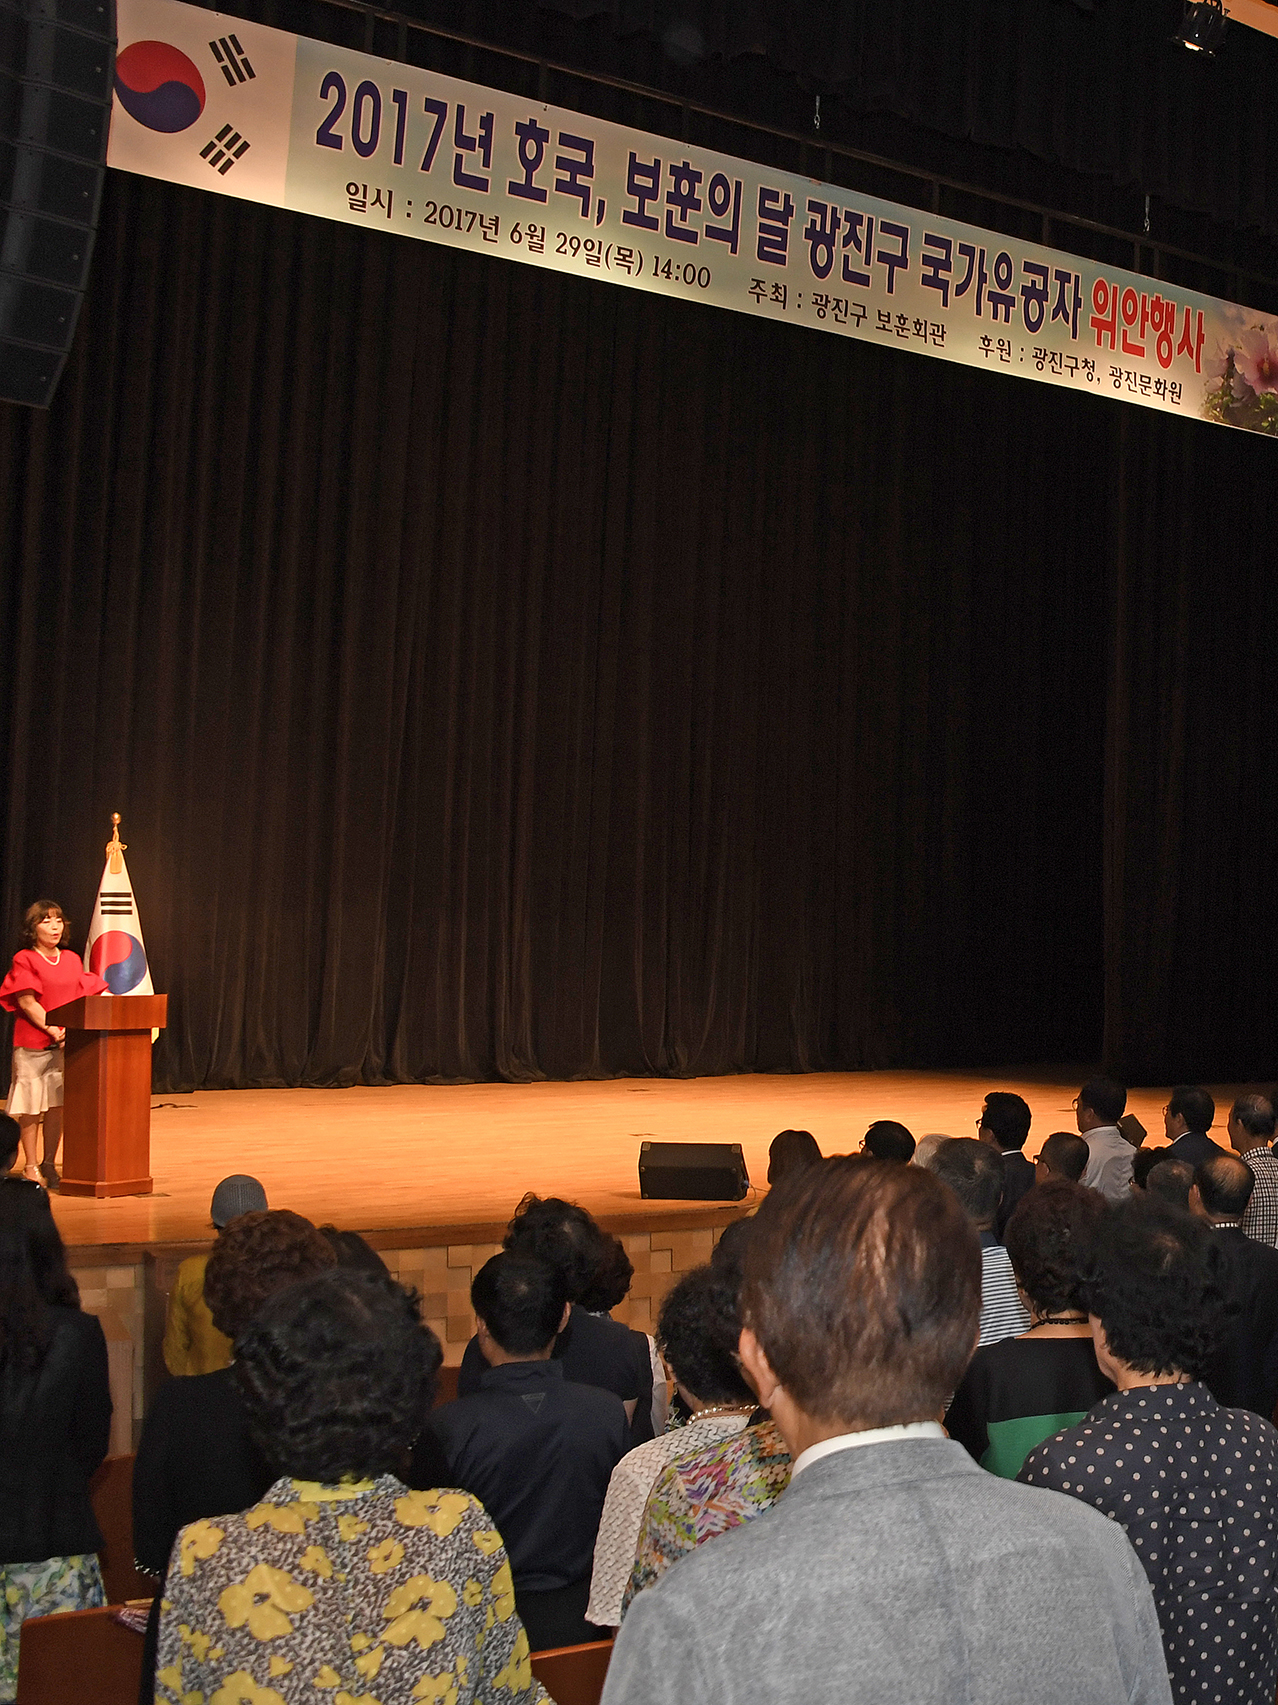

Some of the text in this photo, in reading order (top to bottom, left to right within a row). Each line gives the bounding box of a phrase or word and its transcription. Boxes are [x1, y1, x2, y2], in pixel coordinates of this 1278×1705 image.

[315, 70, 1206, 374] 2017년 호국, 보훈의 달 광진구 국가유공자 위안행사
[423, 200, 500, 243] 2017년
[509, 221, 546, 254] 6월
[555, 232, 644, 277] 29일(목)
[651, 255, 711, 289] 14:00
[811, 292, 868, 327] 광진구
[875, 309, 947, 347] 보훈회관
[1032, 346, 1101, 385] 광진구청,
[1109, 365, 1183, 405] 광진문화원
